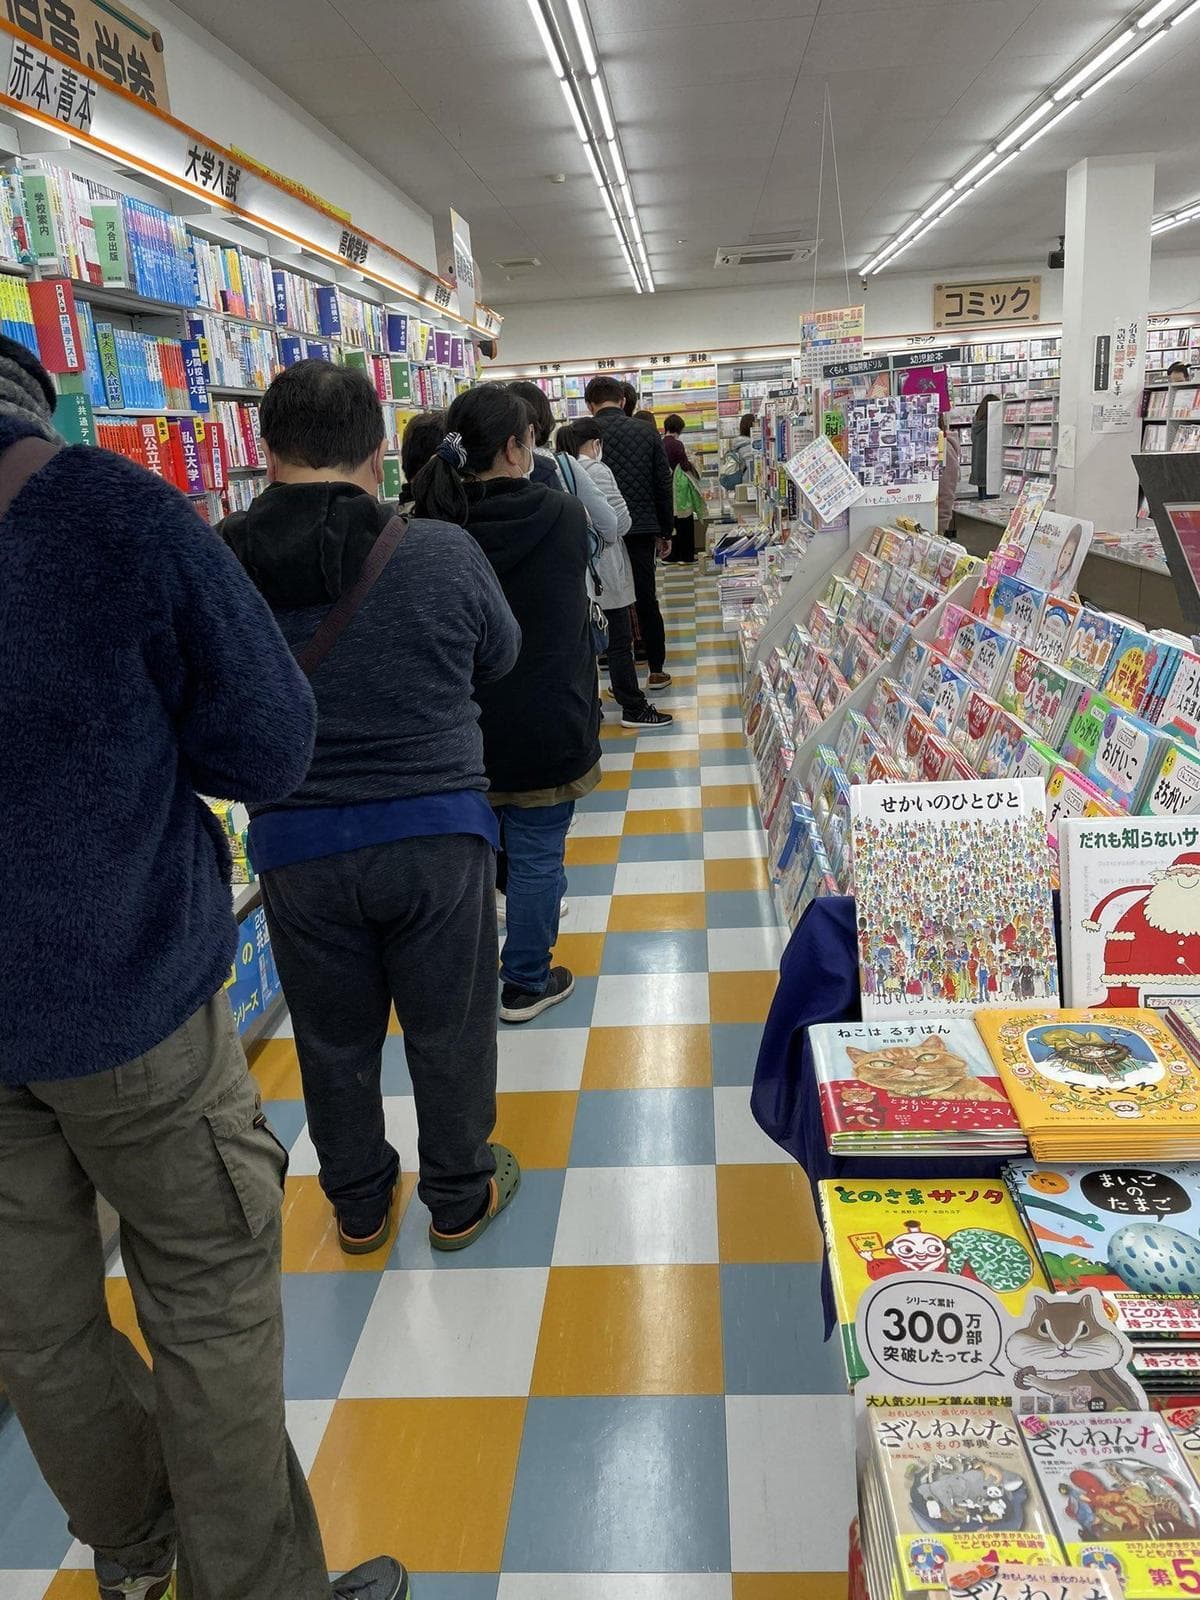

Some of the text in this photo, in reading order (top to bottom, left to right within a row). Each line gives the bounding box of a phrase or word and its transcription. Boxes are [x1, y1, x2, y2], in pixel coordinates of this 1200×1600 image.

[9, 43, 97, 130] 赤本・青本
[184, 144, 241, 203] 大学入試
[34, 192, 50, 236] 学校案内
[106, 221, 120, 262] 河合出版
[944, 286, 1031, 318] コミック
[60, 315, 79, 368] 共通テスト
[906, 336, 936, 346] コミック
[909, 352, 944, 365] 幼児絵本
[185, 358, 197, 395] シリーズ
[182, 430, 199, 482] 私立大学
[1102, 738, 1138, 780] おけいこ
[880, 791, 1020, 813] せかいのひとびと
[241, 942, 254, 965] の
[837, 1025, 951, 1039] ねこは るすばん
[1064, 1080, 1158, 1096] てぶくろ
[1099, 1173, 1157, 1188] まいご
[1126, 1186, 1143, 1197] の
[834, 1185, 1003, 1205] とのさまサンタ
[1107, 1196, 1171, 1212] たまご
[905, 1296, 955, 1308] シリーズ累計
[883, 1346, 983, 1363] 突破したってよ
[876, 1418, 1019, 1448] ざんねんな
[1025, 1425, 1171, 1458] ざんねんな
[906, 1438, 989, 1451] いきもの事典
[1066, 1445, 1137, 1457] いきもの事典
